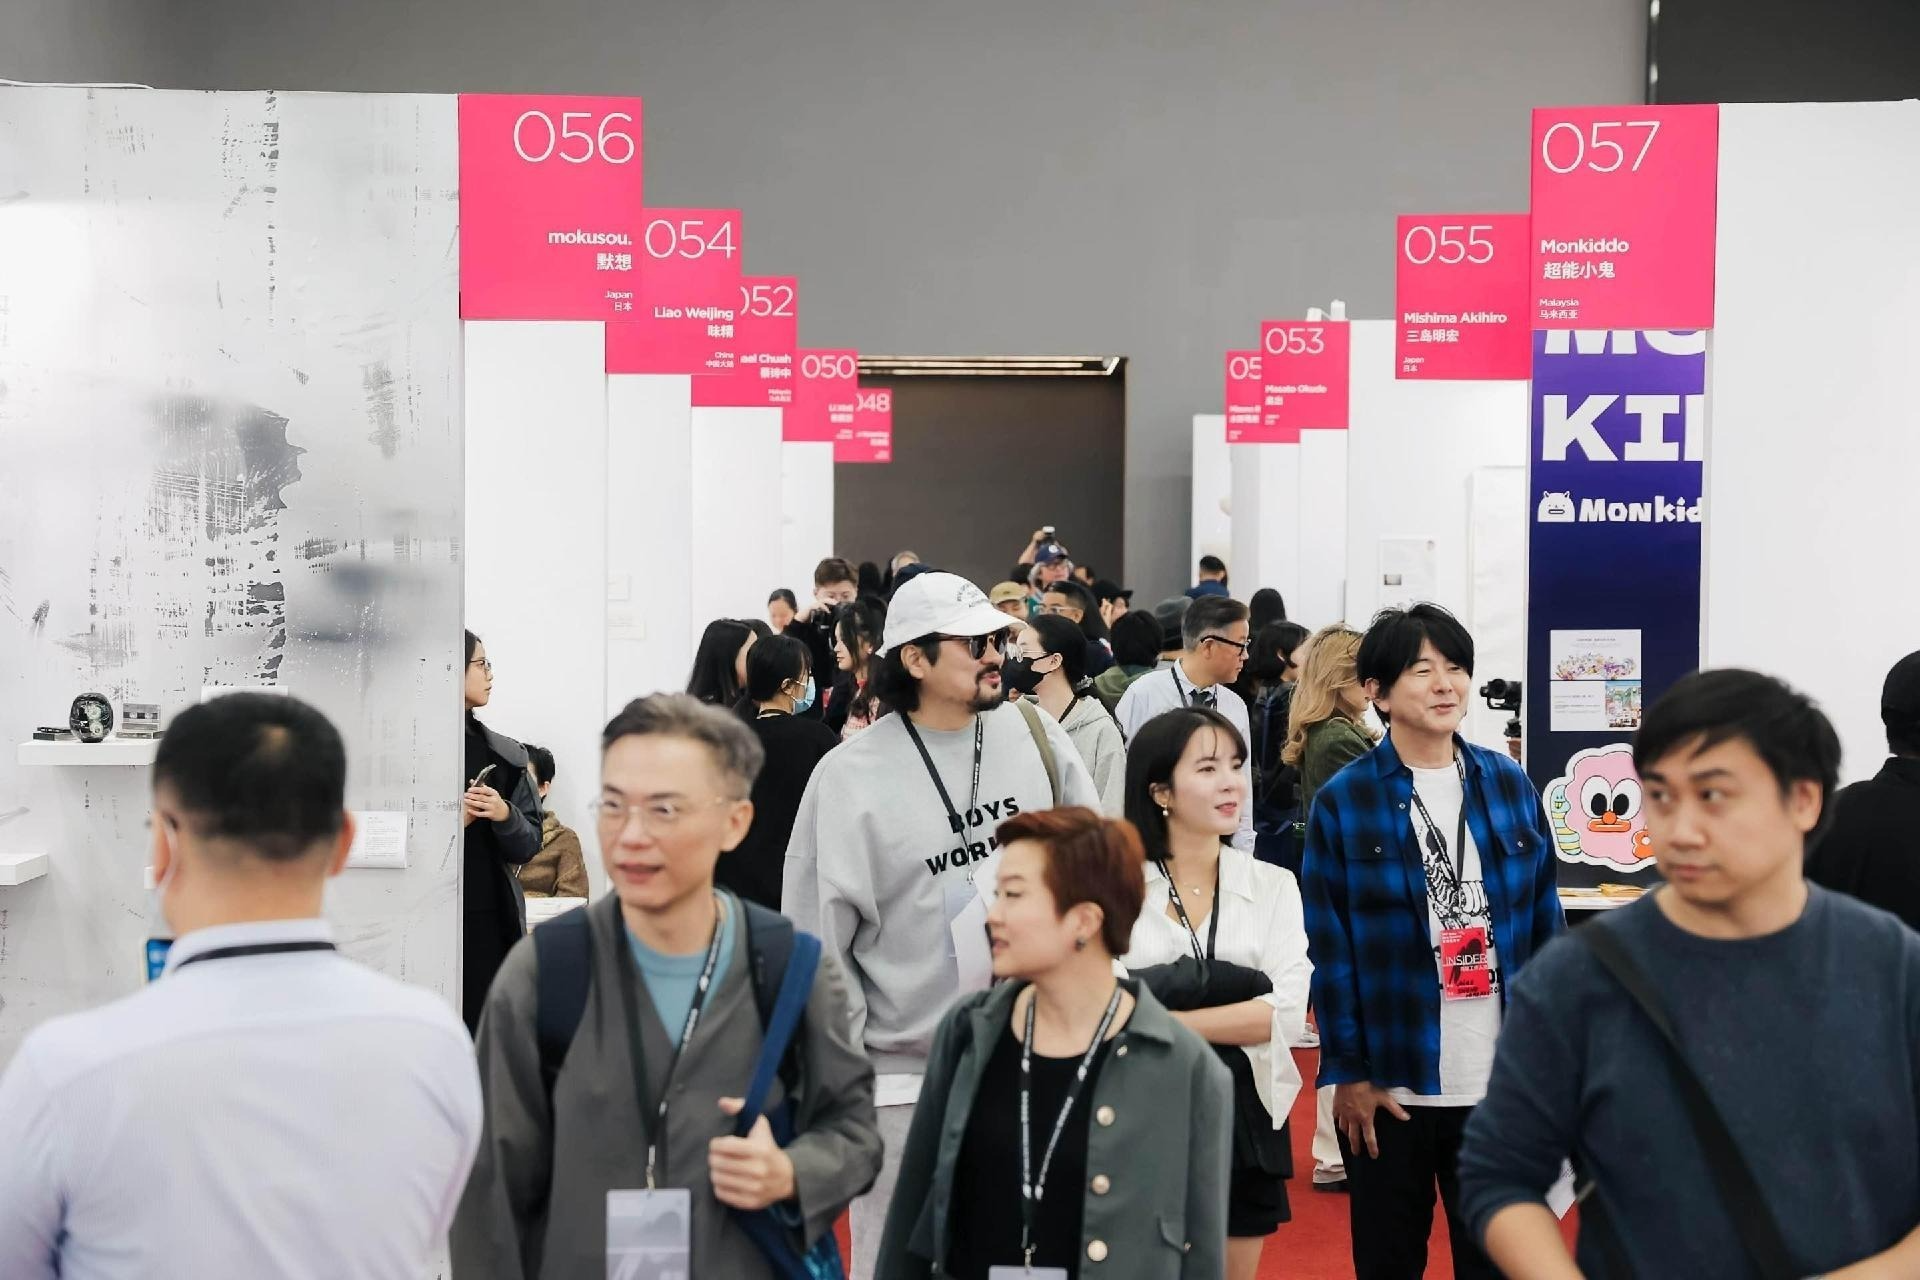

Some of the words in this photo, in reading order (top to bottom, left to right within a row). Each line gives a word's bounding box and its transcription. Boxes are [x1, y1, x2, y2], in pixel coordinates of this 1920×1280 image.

[513, 110, 635, 164] 056
[1542, 121, 1661, 174] 057
[548, 229, 633, 246] mokusou.
[645, 219, 737, 259] 054
[1404, 225, 1494, 264] 055
[1540, 238, 1630, 254] Monkiddo
[1543, 260, 1616, 280] 超能小鬼
[604, 289, 633, 300] Japan
[613, 301, 633, 313] 日本
[1539, 298, 1580, 308] Malaysia
[654, 306, 683, 319] Liao
[685, 306, 734, 321] Weijing
[1404, 311, 1458, 324] Mishima
[1459, 311, 1508, 324] Akihiro
[1538, 309, 1579, 319] 马来西亚
[1265, 327, 1325, 354] 053
[1406, 328, 1460, 343] 三岛明宏
[801, 354, 856, 379] 050
[1229, 356, 1262, 380] 05
[1403, 356, 1425, 364] Japan
[957, 797, 1020, 830] OYS
[1445, 953, 1488, 967] INSIDER
